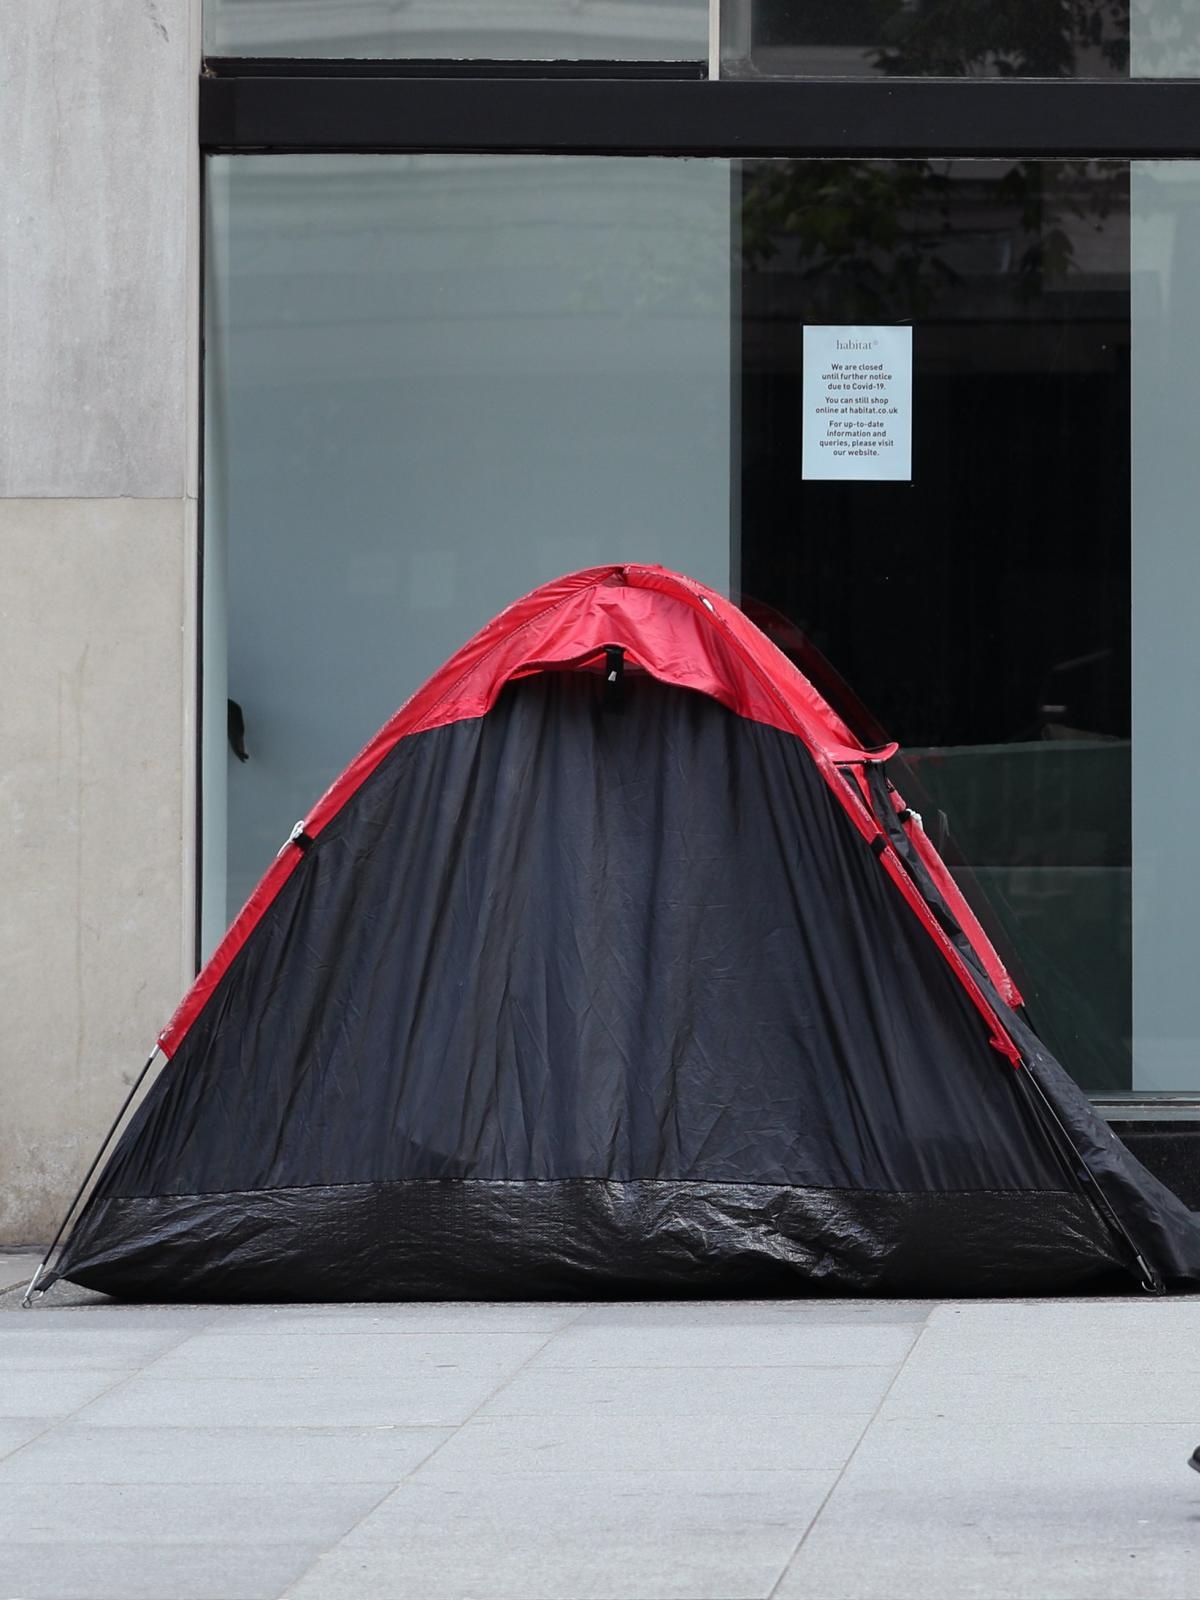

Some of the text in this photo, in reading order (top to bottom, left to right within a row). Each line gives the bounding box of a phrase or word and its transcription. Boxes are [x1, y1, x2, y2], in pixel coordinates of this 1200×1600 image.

[871, 397, 889, 405] shop
[844, 420, 884, 429] up-to-date
[819, 440, 850, 448] queries,
[852, 439, 876, 448] please
